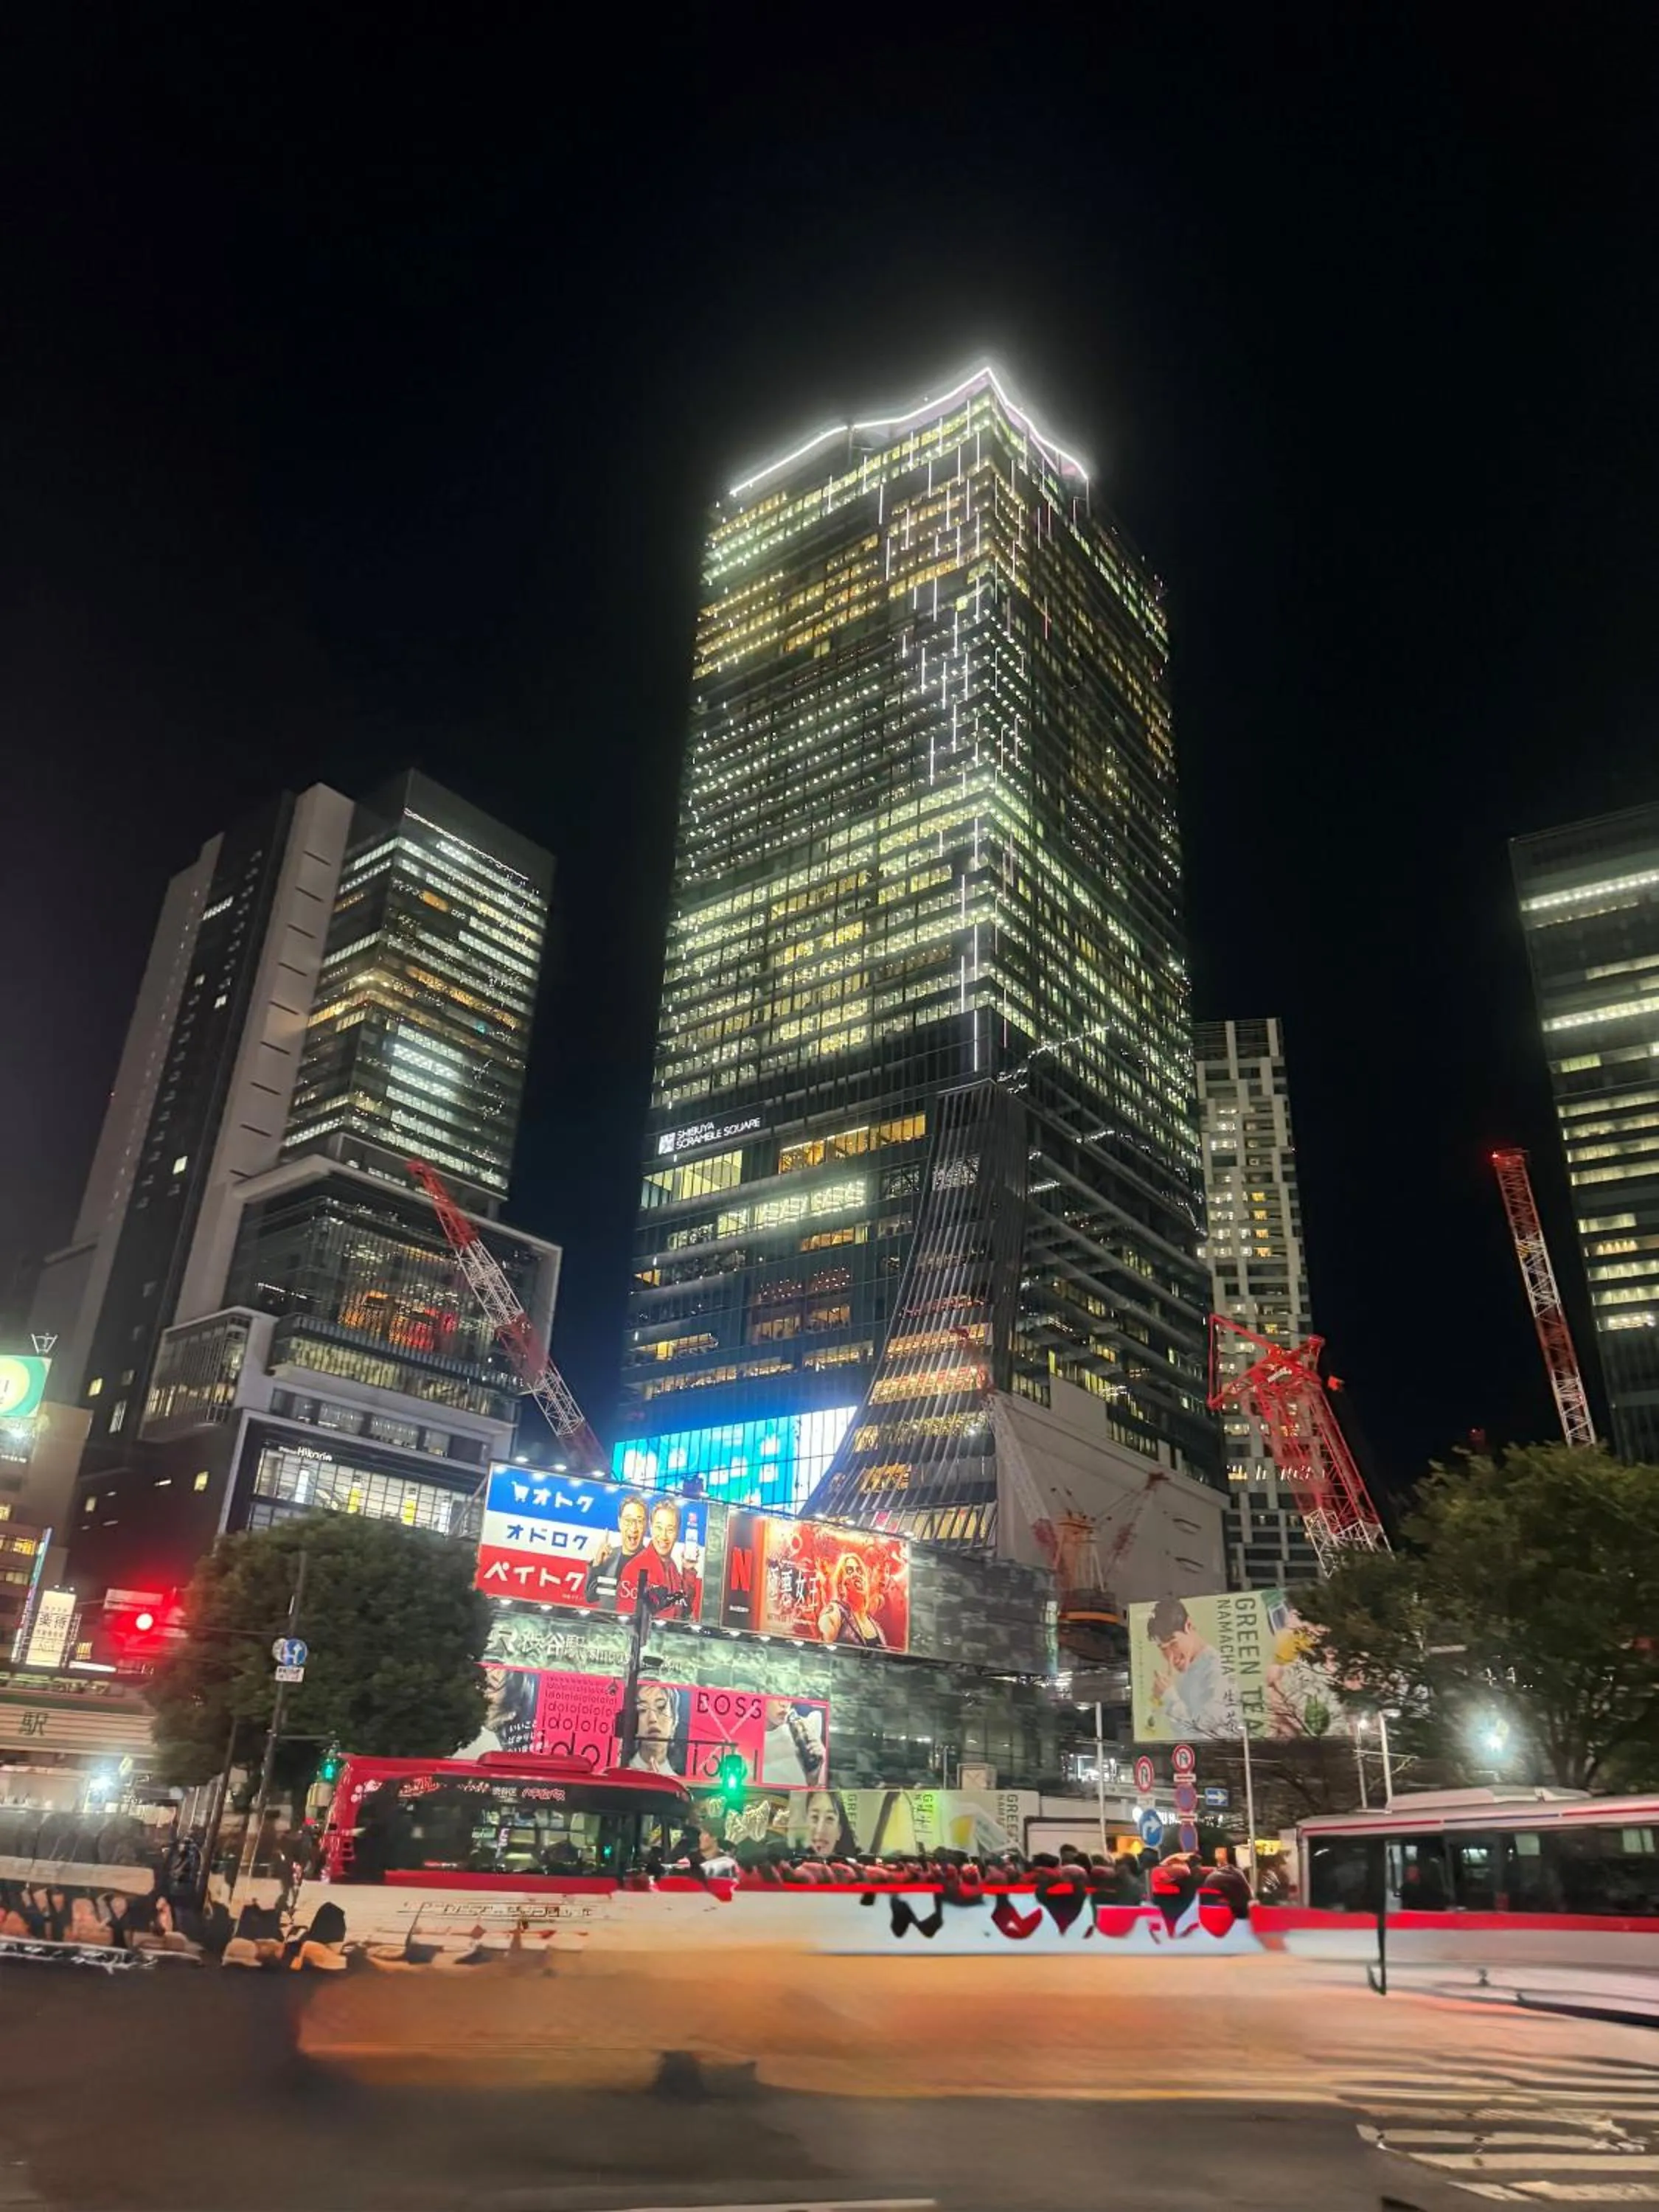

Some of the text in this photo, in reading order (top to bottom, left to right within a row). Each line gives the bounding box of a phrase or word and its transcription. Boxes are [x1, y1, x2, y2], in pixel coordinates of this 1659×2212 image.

[675, 1117, 761, 1150] SCRAMBLE SQUARE
[677, 1121, 714, 1139] SHIBUYA
[532, 1488, 594, 1514] オトク
[507, 1524, 589, 1551] オドロク
[483, 1561, 585, 1592] ペイトク
[731, 1547, 752, 1592] N
[1217, 1598, 1236, 1676] NAMACHA
[1234, 1597, 1262, 1675] GREEN
[697, 1691, 762, 1720] BOSS
[19, 1711, 49, 1736] 駅
